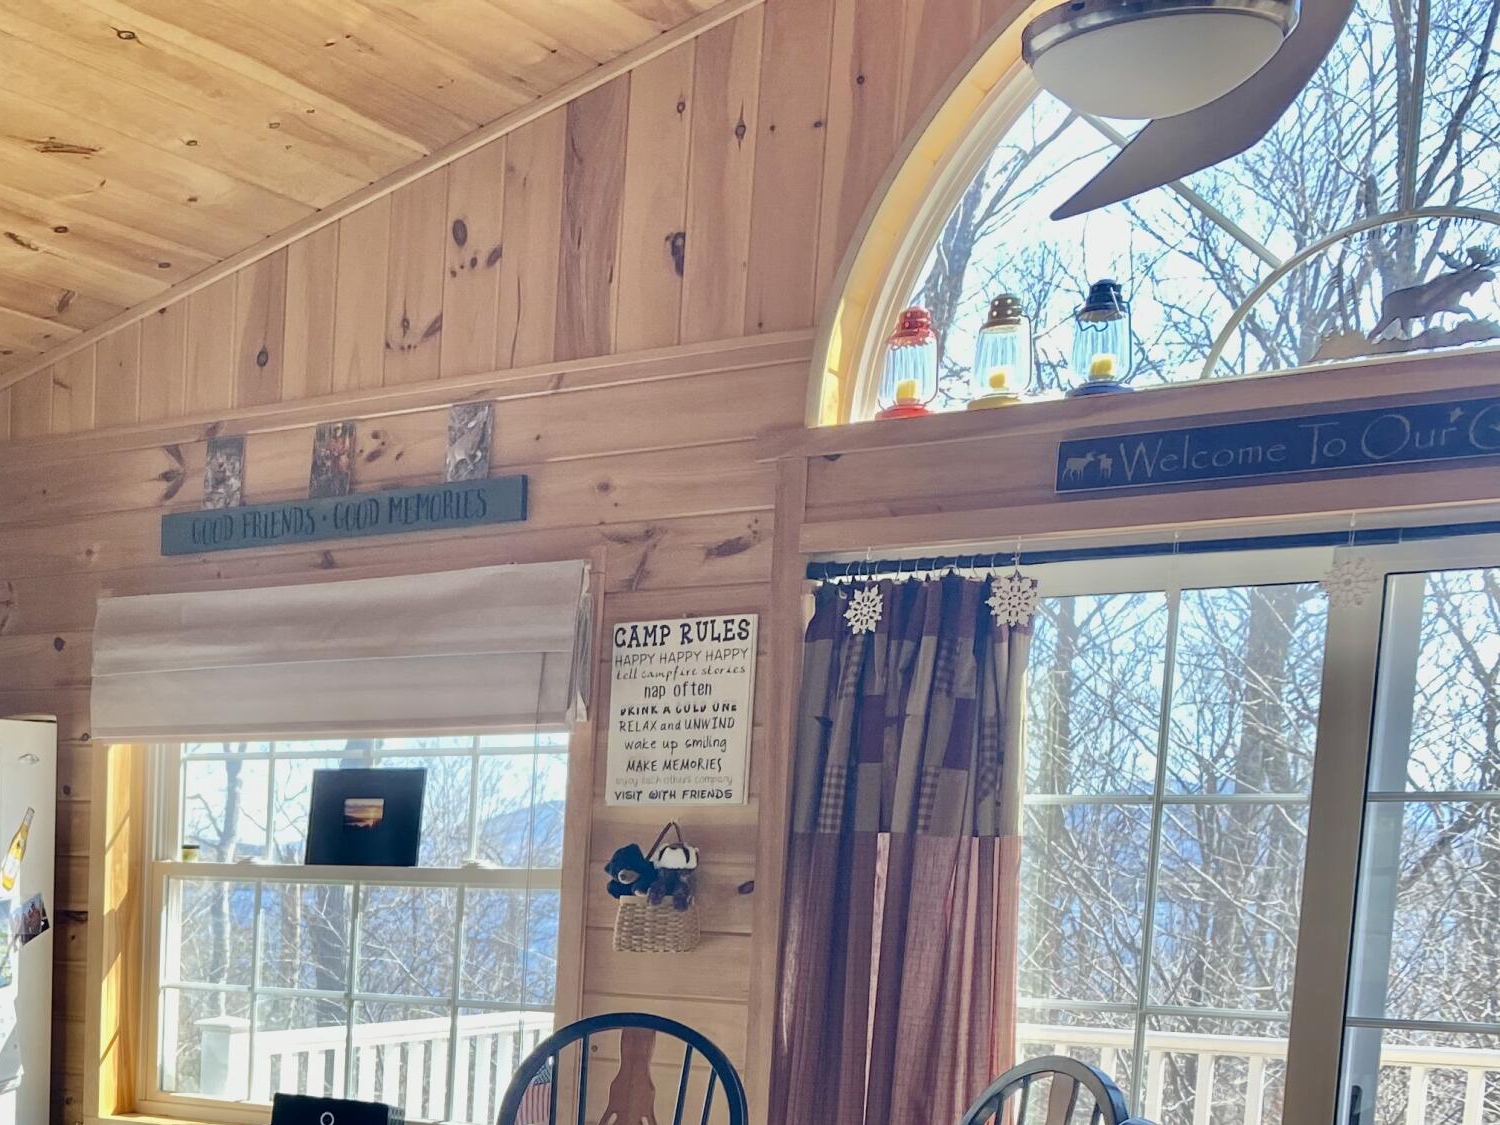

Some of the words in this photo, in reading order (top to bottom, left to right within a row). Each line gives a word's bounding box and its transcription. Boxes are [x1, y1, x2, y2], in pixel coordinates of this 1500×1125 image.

[1119, 434, 1287, 482] Welcome
[1298, 421, 1348, 465] To
[1360, 413, 1458, 460] Our
[191, 513, 235, 546] GOOD
[242, 506, 316, 540] FRIENDS
[333, 498, 380, 532] GOOD
[388, 487, 488, 525] MEMORIES
[614, 624, 671, 648] CAMP
[679, 618, 751, 646] RULES
[615, 652, 656, 667] HAPPY
[660, 650, 702, 665] HAPPY
[706, 647, 749, 661] HAPPY
[616, 667, 638, 680] tell
[641, 665, 698, 682] campfire
[701, 664, 746, 675] stories
[644, 684, 666, 700] nap
[673, 681, 712, 697] often
[620, 705, 659, 717] DRINK
[662, 706, 671, 715] A
[619, 720, 658, 733] RELAX
[660, 719, 681, 732] and
[684, 716, 735, 730] UNWIND
[624, 738, 657, 750] wake
[662, 739, 679, 755] up
[684, 735, 727, 753] smiling
[626, 759, 658, 773] MAKE
[662, 757, 722, 773] MEMORIES
[614, 790, 643, 801] VISIT
[648, 789, 676, 800] WITH
[681, 788, 733, 800] FRIENDS
